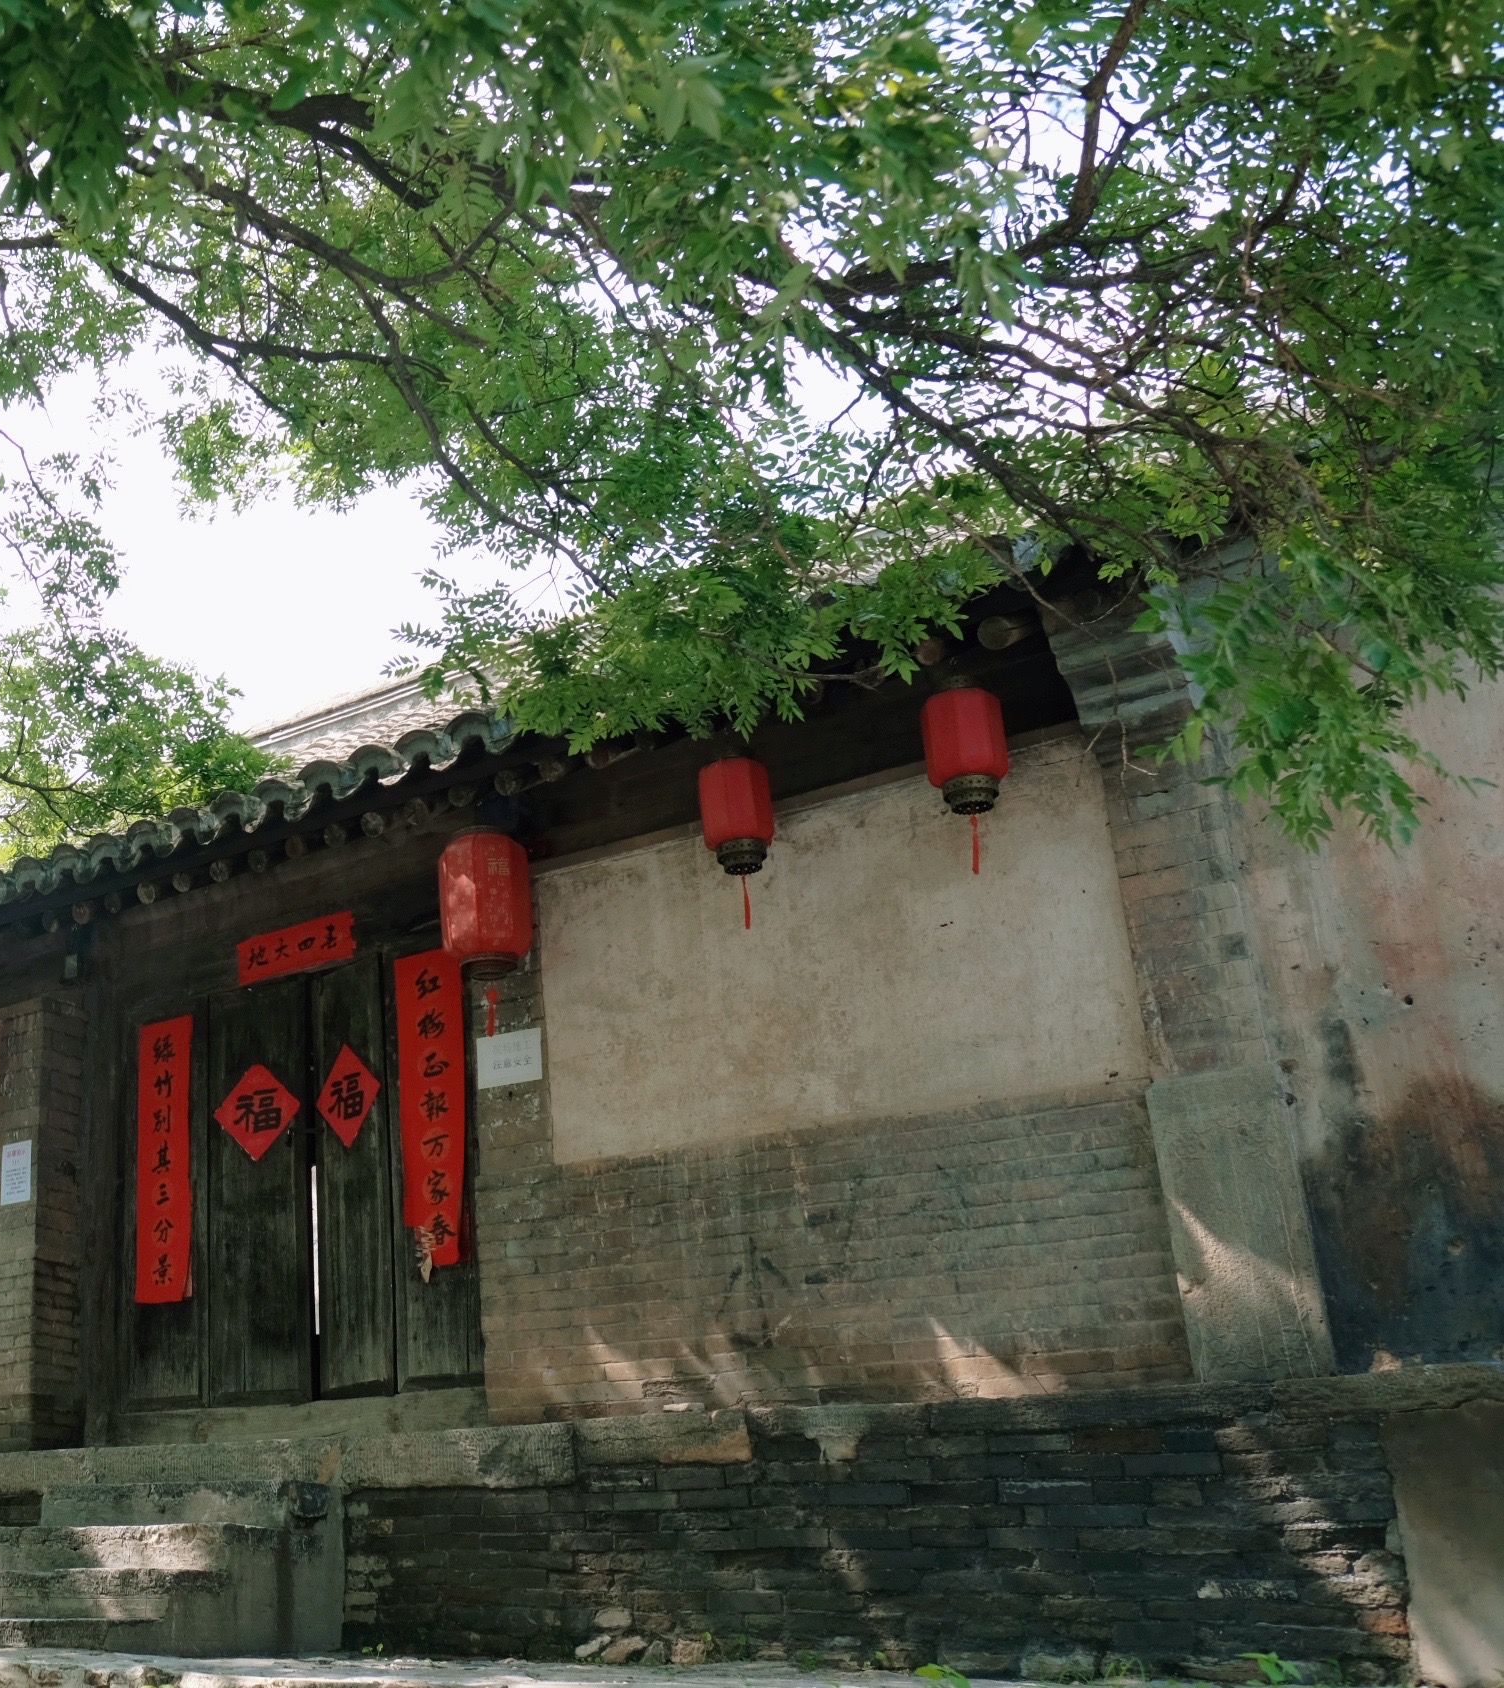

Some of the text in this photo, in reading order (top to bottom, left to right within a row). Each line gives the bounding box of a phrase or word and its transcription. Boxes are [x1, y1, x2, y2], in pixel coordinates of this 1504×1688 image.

[493, 1054, 532, 1070] 注意安全
[235, 1088, 282, 1134] 福
[330, 1071, 363, 1120] 福
